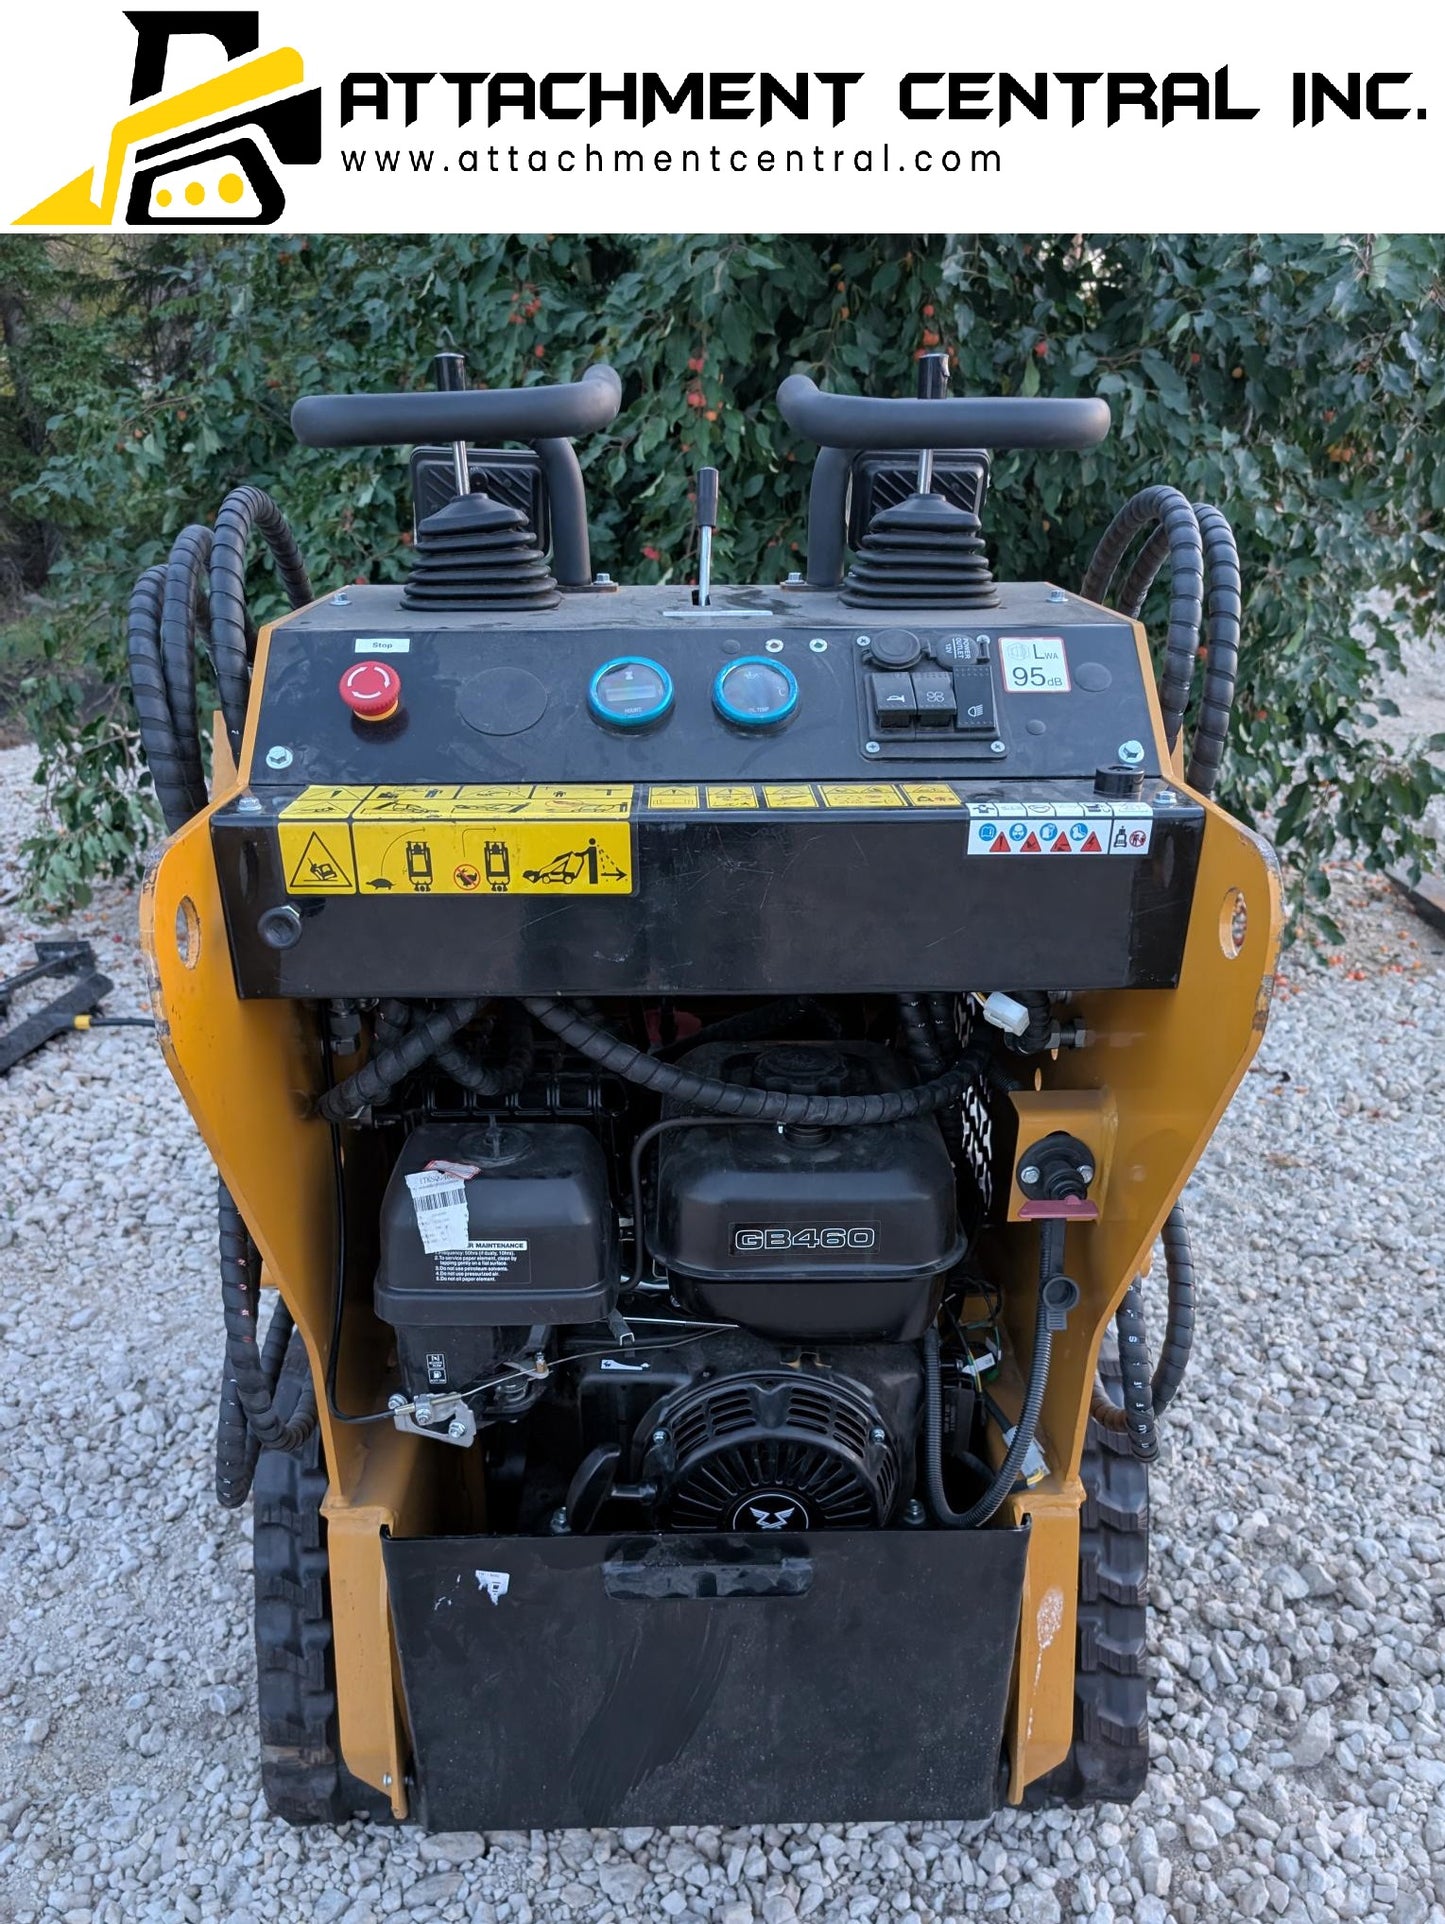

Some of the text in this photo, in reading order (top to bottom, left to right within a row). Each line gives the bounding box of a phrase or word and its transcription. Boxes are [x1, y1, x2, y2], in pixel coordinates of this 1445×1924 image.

[945, 643, 953, 654] 12V
[955, 637, 964, 659] OUTLET
[963, 637, 971, 660] POWER
[735, 1227, 876, 1251] GB460
